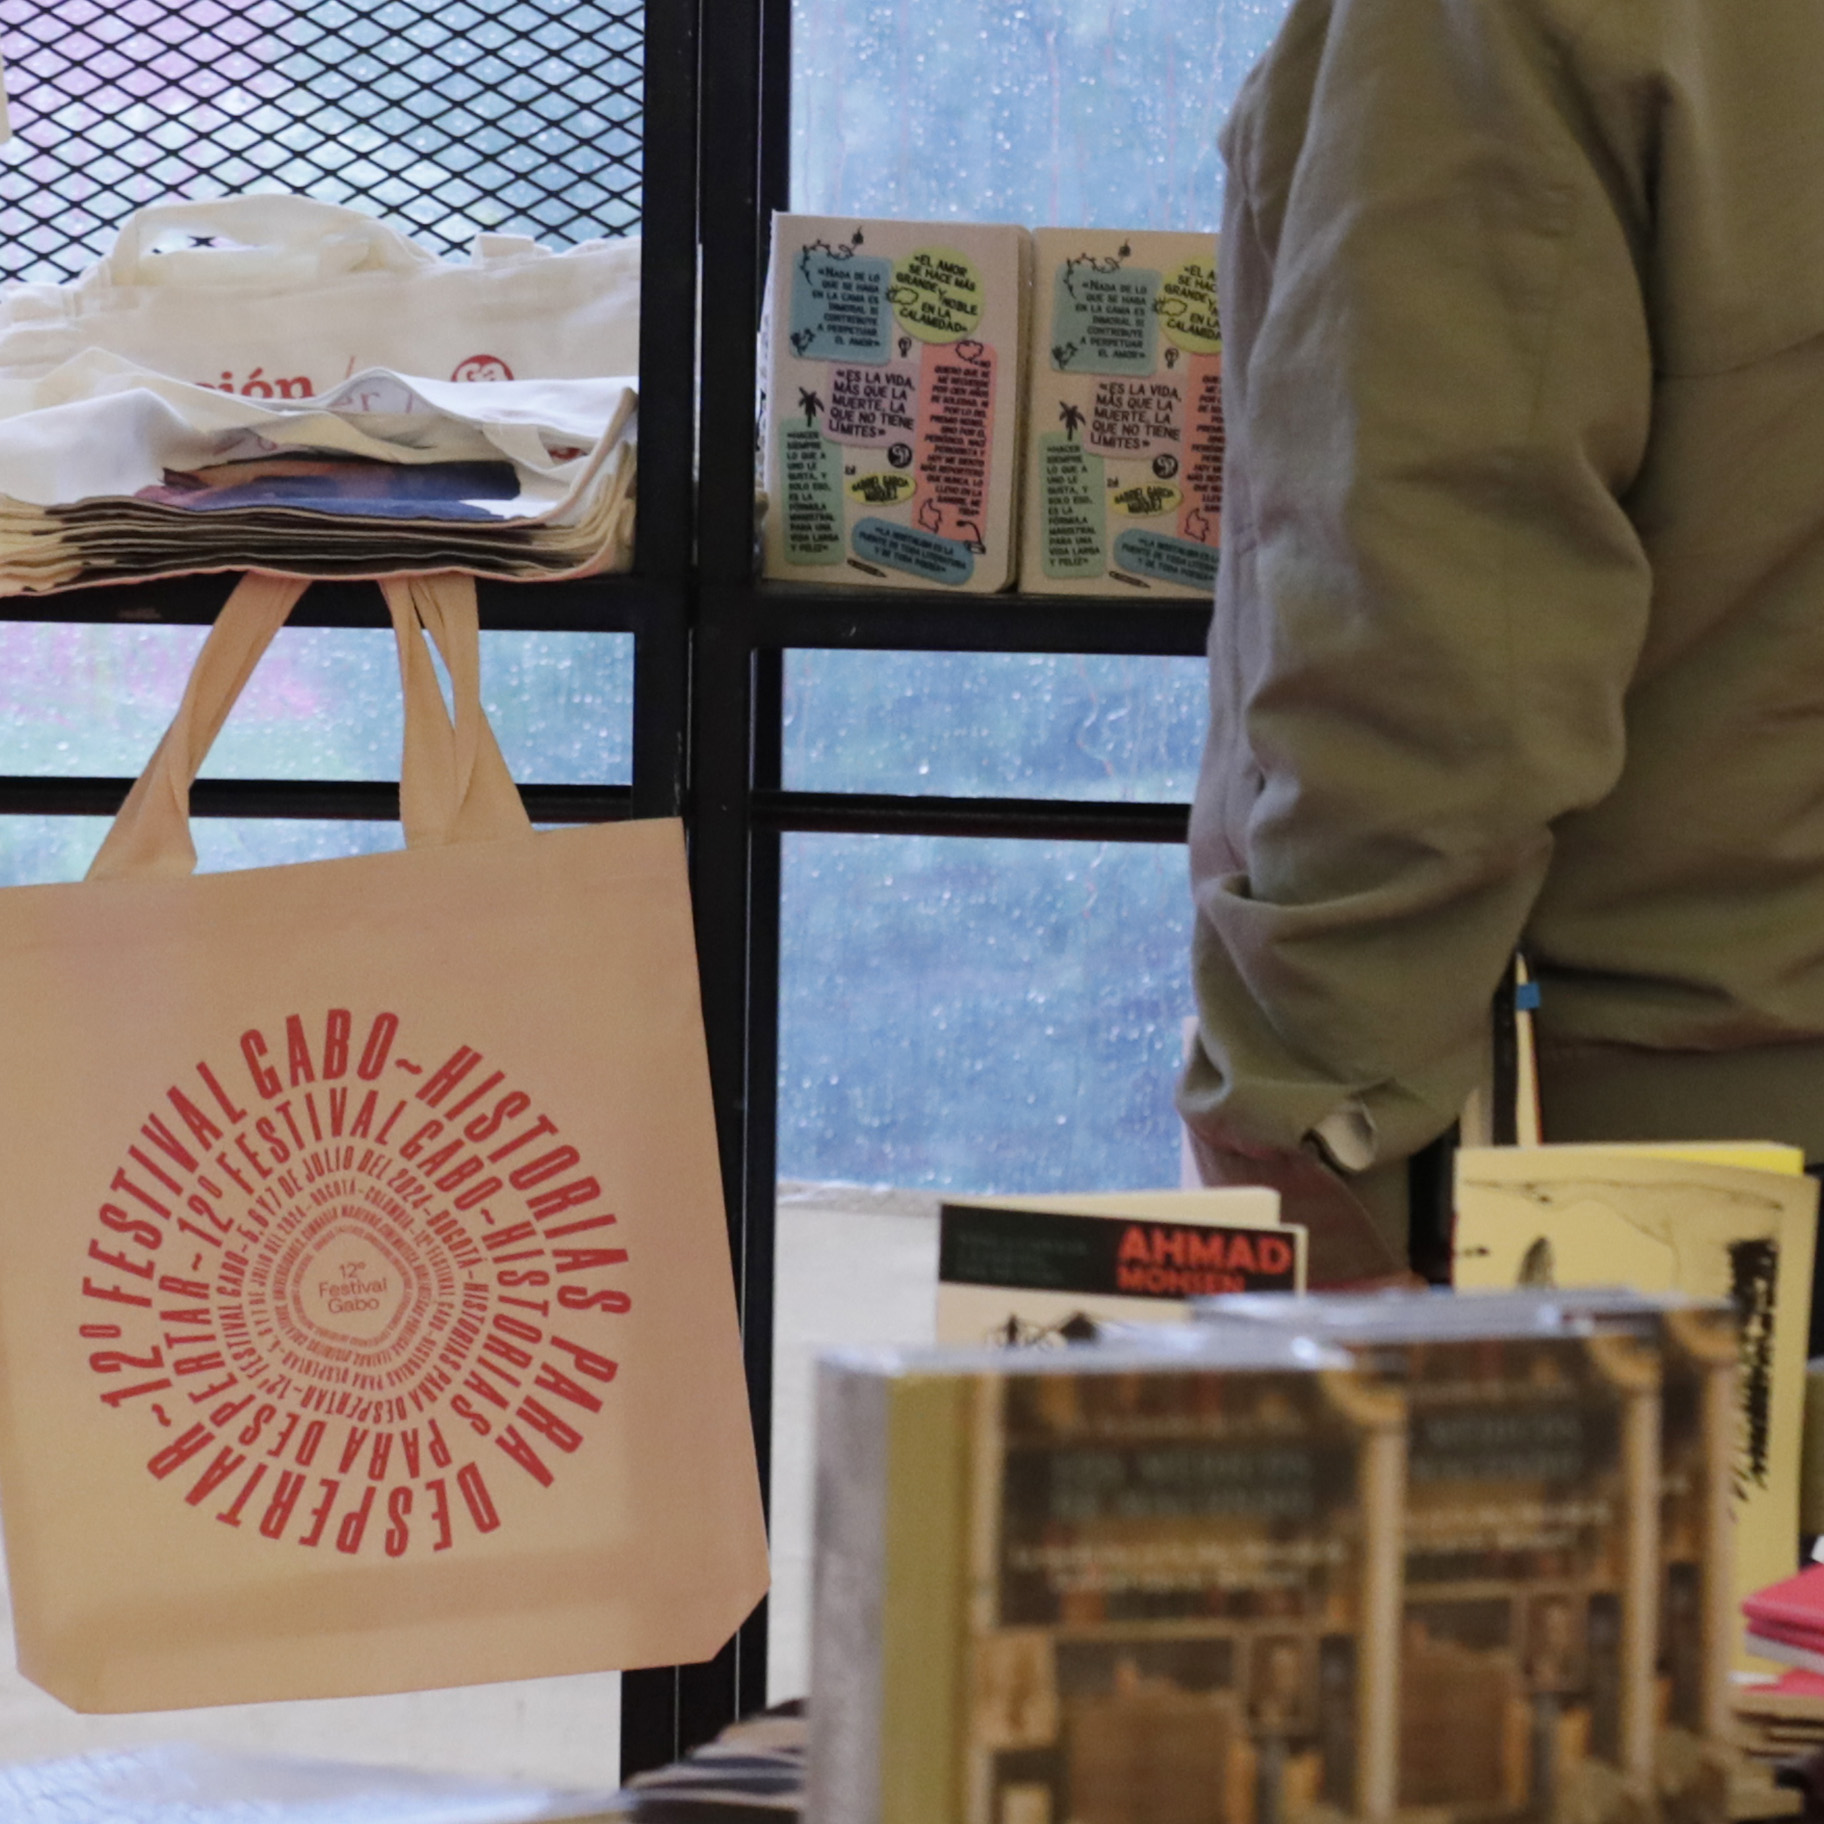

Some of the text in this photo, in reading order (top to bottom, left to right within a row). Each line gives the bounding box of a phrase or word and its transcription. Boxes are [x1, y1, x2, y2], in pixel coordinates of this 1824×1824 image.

[895, 272, 939, 293] GRANDE
[908, 263, 977, 292] SE HACE MÁS
[936, 259, 968, 277] AMOR
[921, 301, 952, 319] EN LA
[943, 297, 979, 317] NOBLE
[833, 380, 908, 401] MÁS QUE LA
[865, 371, 881, 384] LA
[1129, 383, 1145, 395] LA
[829, 406, 915, 431] QUE NO TIENE
[890, 401, 906, 415] LA
[1127, 395, 1153, 410] QUE
[1157, 399, 1174, 412] LA
[1155, 412, 1171, 424] LA
[1092, 420, 1182, 442] QUE NO TIENE
[239, 1008, 399, 1100] GABO
[215, 1086, 408, 1197] FESTIVAL
[302, 1145, 356, 1183] JULIO
[357, 1147, 393, 1181] DEL
[398, 1119, 504, 1211] GABO
[414, 1044, 632, 1314] HISTORIAS
[81, 1060, 248, 1309] FESTIVAL
[1117, 1225, 1294, 1274] AHMAD
[318, 1277, 388, 1298] Festival
[328, 1296, 381, 1315] Gabo
[217, 1304, 270, 1379] FESTIVAL
[437, 1282, 490, 1372] HISTORIAS
[450, 1220, 551, 1437] HISTORIAS
[158, 1274, 328, 1467] DESPERTAR
[407, 1364, 452, 1413] PARA
[494, 1334, 619, 1489] PARA
[337, 1417, 453, 1482] PARA
[146, 1421, 501, 1558] DESPERTAR
